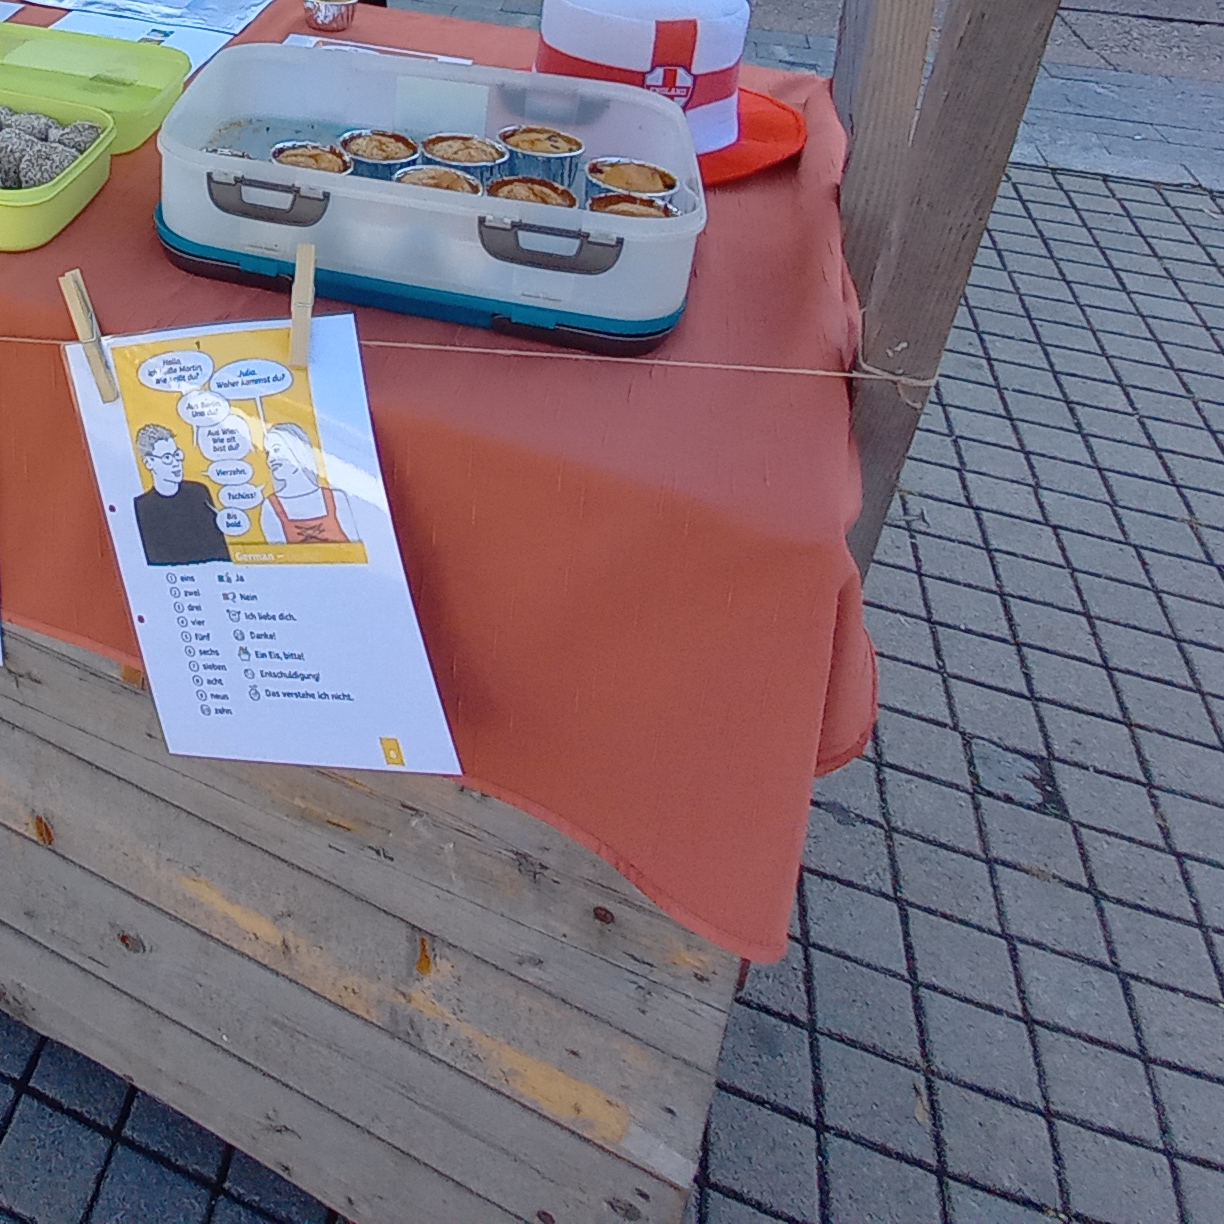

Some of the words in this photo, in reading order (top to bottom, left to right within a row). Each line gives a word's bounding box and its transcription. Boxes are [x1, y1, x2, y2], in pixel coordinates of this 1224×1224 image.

[216, 380, 239, 389] Woher
[235, 551, 274, 561] German
[236, 574, 244, 582] Ja
[239, 593, 258, 601] Nein
[257, 612, 276, 621] liebe
[190, 618, 205, 626] vier
[250, 631, 276, 640] Danke!
[255, 650, 267, 659] Ein
[265, 689, 281, 697] Das
[282, 691, 315, 699] verstehe
